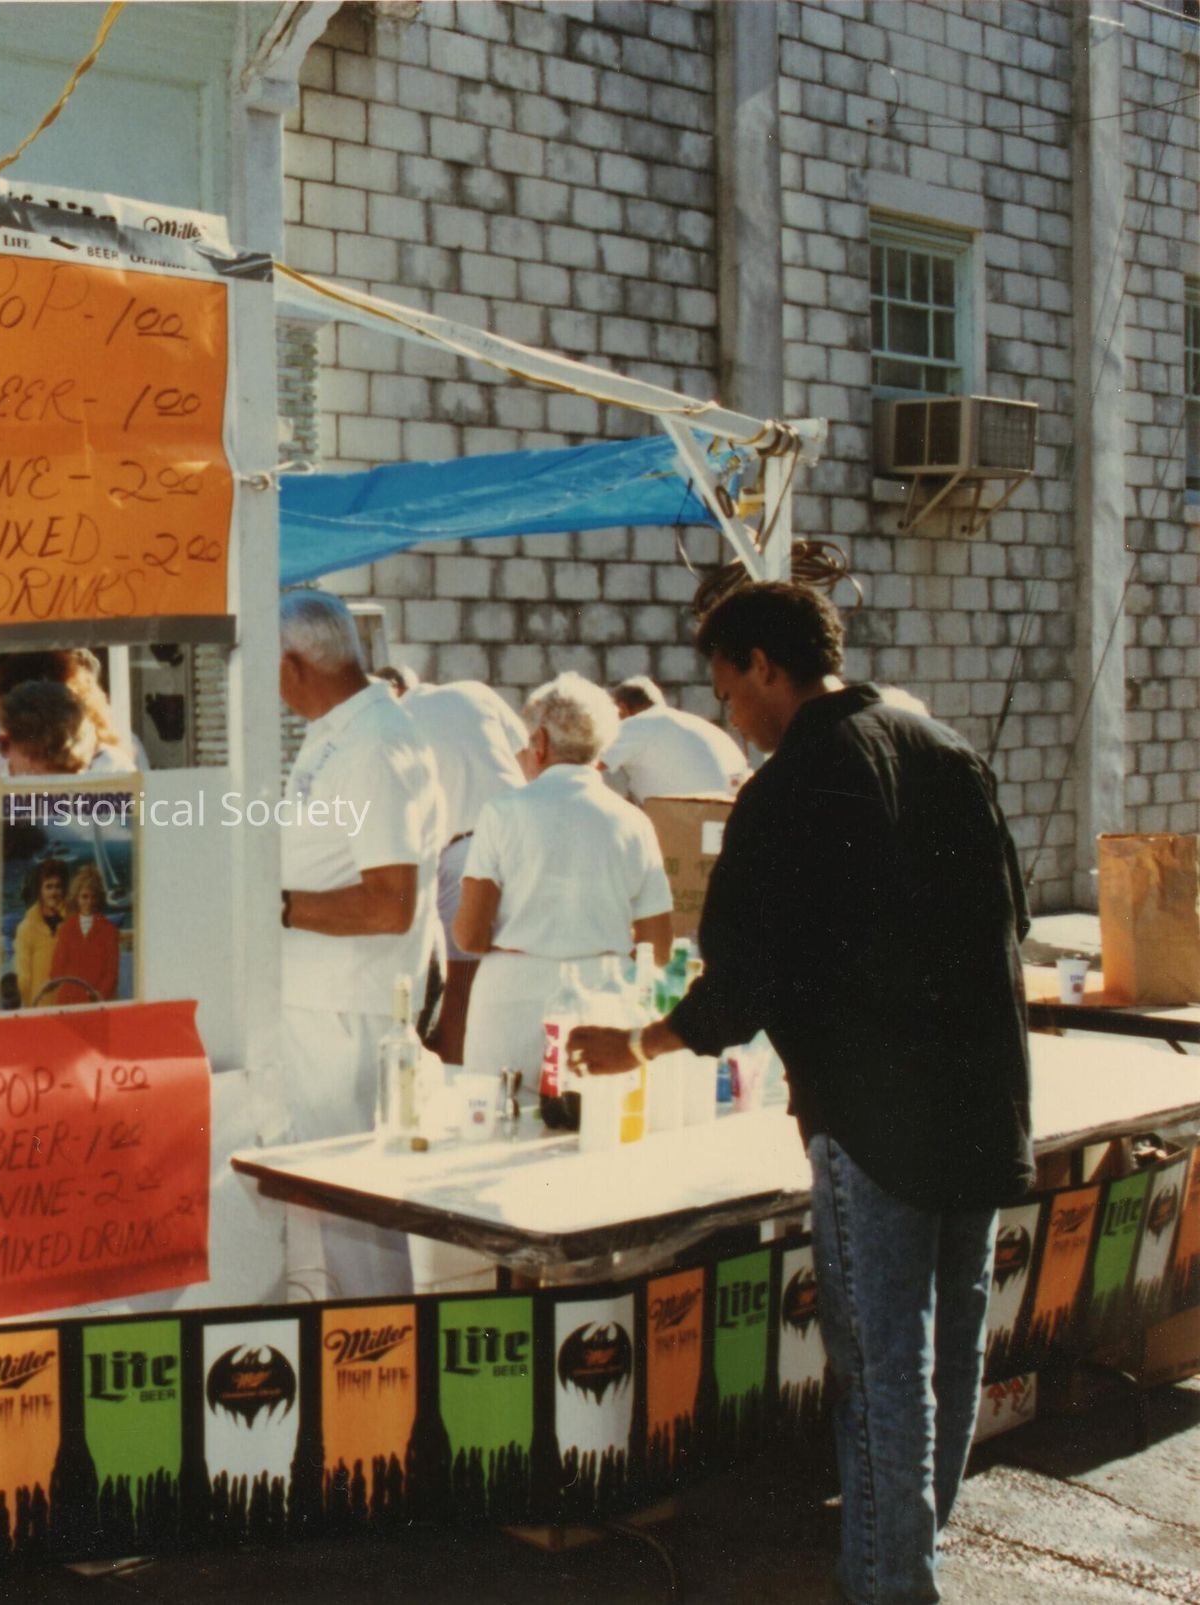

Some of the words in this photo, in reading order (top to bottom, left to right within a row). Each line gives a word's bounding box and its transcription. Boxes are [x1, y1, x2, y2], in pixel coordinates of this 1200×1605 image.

[718, 1280, 768, 1329] Lite
[324, 1324, 413, 1365] Miller
[443, 1326, 530, 1377] Lite
[86, 1351, 178, 1402] Lite
[492, 1363, 529, 1378] BEER
[139, 1388, 176, 1403] BEER
